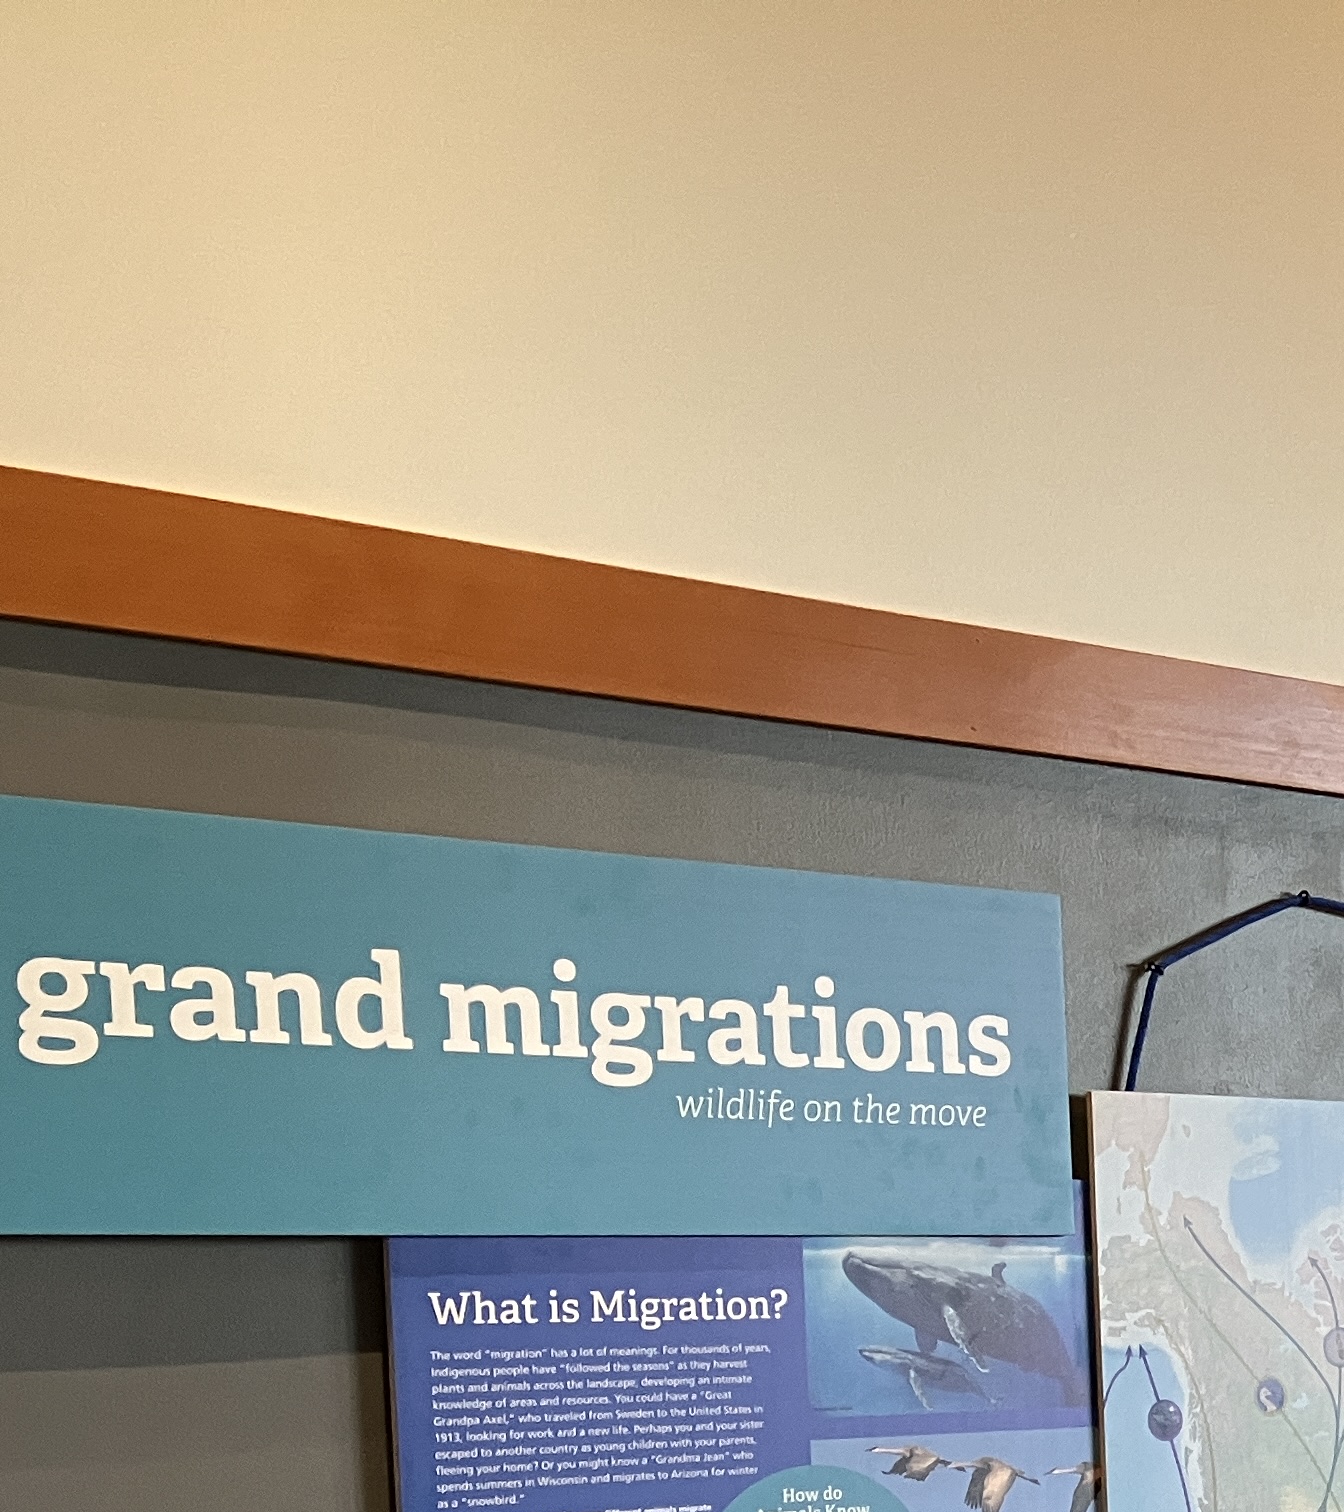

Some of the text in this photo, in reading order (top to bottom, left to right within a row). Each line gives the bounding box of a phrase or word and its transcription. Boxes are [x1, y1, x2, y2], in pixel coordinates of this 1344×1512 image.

[15, 948, 1011, 1088] grand migrations
[676, 1086, 987, 1129] wildlife on the move
[428, 1289, 788, 1330] What is Migration?
[429, 1350, 451, 1361] The
[452, 1348, 482, 1361] word
[550, 1347, 569, 1358] has
[578, 1346, 594, 1357] lot
[595, 1345, 608, 1357] of
[661, 1344, 679, 1355] For
[679, 1343, 731, 1355] thousands
[730, 1342, 743, 1354] of
[430, 1366, 491, 1378] Indigenous
[492, 1363, 530, 1377] people
[531, 1363, 557, 1375] have
[612, 1360, 631, 1373] the
[676, 1361, 688, 1371] as
[689, 1359, 712, 1372] they
[712, 1358, 748, 1369] harvest
[431, 1383, 465, 1395] plants
[466, 1381, 489, 1393] and
[490, 1380, 531, 1392] animals
[532, 1380, 565, 1391] across
[565, 1378, 584, 1390] the
[640, 1375, 696, 1388] developing
[711, 1374, 753, 1385] intimate
[431, 1397, 493, 1410] knowledge
[508, 1398, 538, 1408] areas
[538, 1394, 560, 1406] and
[612, 1393, 634, 1404] You
[634, 1391, 663, 1404] could
[664, 1390, 689, 1402] have
[432, 1415, 481, 1427] Grandpa
[517, 1412, 542, 1424] who
[543, 1410, 587, 1422] traveled
[588, 1409, 614, 1420] from
[614, 1407, 655, 1420] Sweden
[669, 1406, 687, 1418] the
[688, 1404, 722, 1417] United
[722, 1404, 752, 1416] States
[465, 1430, 507, 1442] looking
[508, 1428, 525, 1440] for
[526, 1427, 555, 1439] work
[556, 1426, 577, 1438] and
[587, 1427, 611, 1436] new
[633, 1423, 673, 1434] Perhaps
[673, 1423, 693, 1435] you
[694, 1420, 714, 1432] and
[714, 1421, 738, 1433] your
[738, 1419, 765, 1430] sister
[434, 1446, 479, 1461] escaped
[494, 1444, 537, 1457] another
[538, 1443, 579, 1456] country
[592, 1442, 626, 1455] young
[626, 1438, 668, 1451] children
[669, 1437, 693, 1448] with
[693, 1437, 717, 1450] your
[435, 1464, 474, 1476] fleeing
[475, 1464, 501, 1475] your
[502, 1460, 539, 1473] home?
[556, 1460, 577, 1471] you
[577, 1457, 609, 1470] might
[610, 1455, 640, 1467] know
[731, 1449, 754, 1460] who
[435, 1466, 759, 1494] spends summers Wisconsin and migrates Arizona for winter
[783, 1486, 842, 1503] How do
